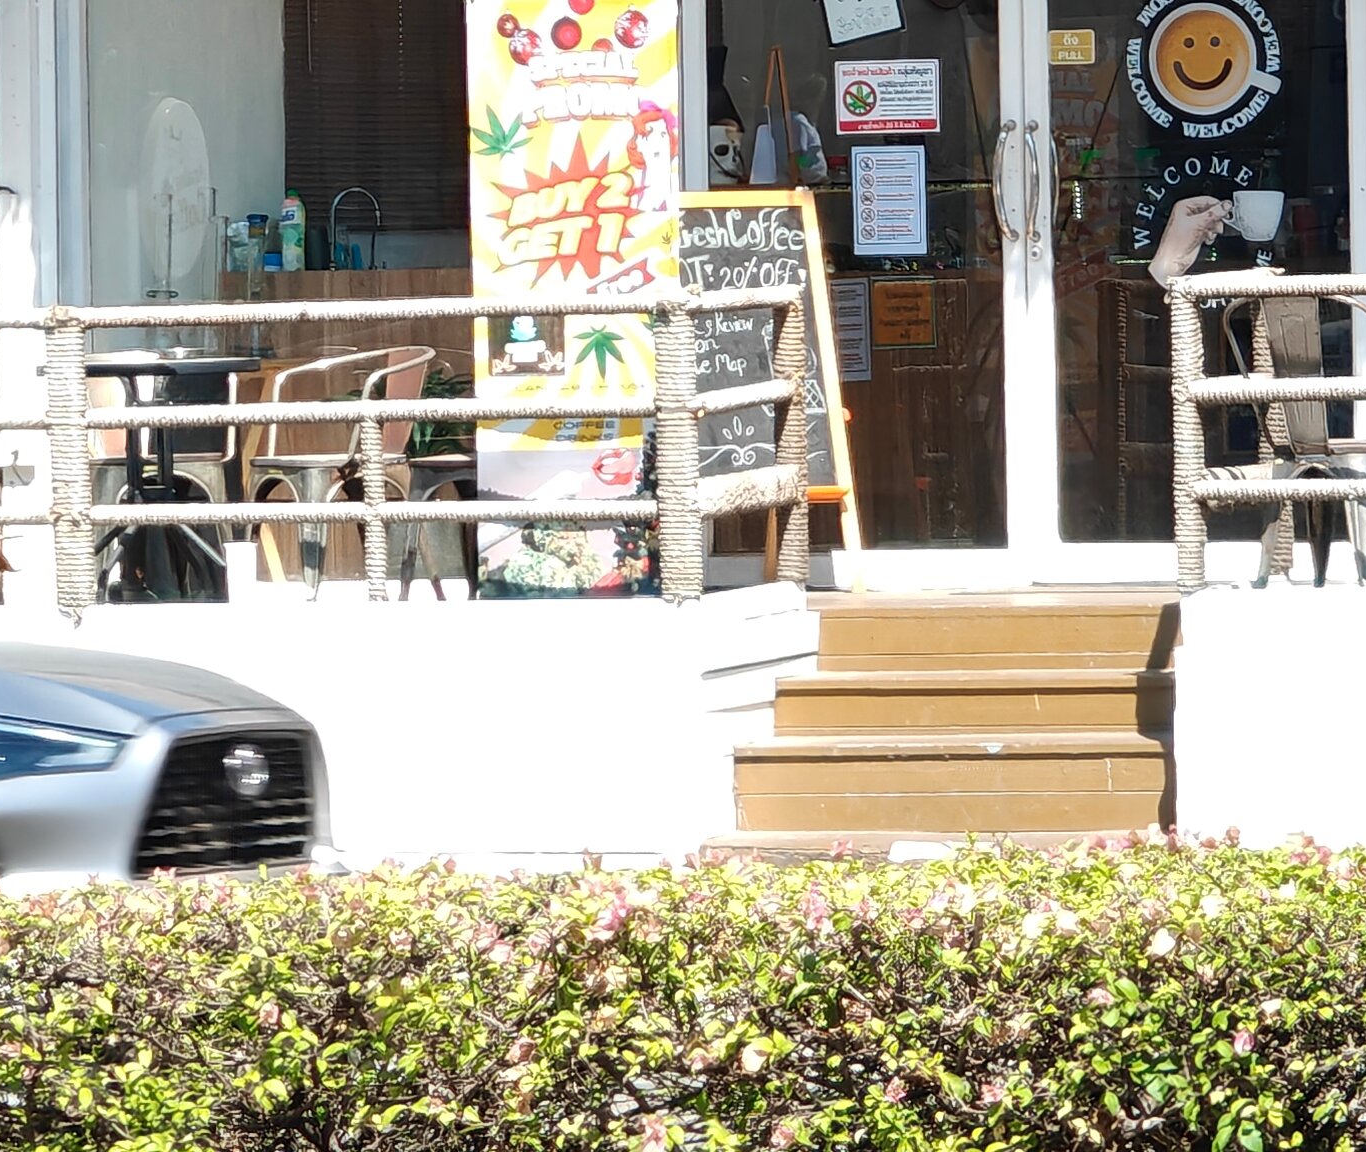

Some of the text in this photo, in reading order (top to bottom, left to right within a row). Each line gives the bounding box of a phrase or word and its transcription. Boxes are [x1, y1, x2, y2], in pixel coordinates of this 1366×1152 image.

[1058, 50, 1085, 60] PULL
[1126, 37, 1174, 129] WELCOME
[1181, 91, 1271, 139] WELCOME
[506, 170, 635, 228] BUY 2
[1132, 155, 1254, 250] WELCOME
[497, 212, 627, 267] GET 1
[726, 207, 806, 252] Coffee
[714, 353, 748, 378] Map
[553, 420, 615, 430] COFFEE
